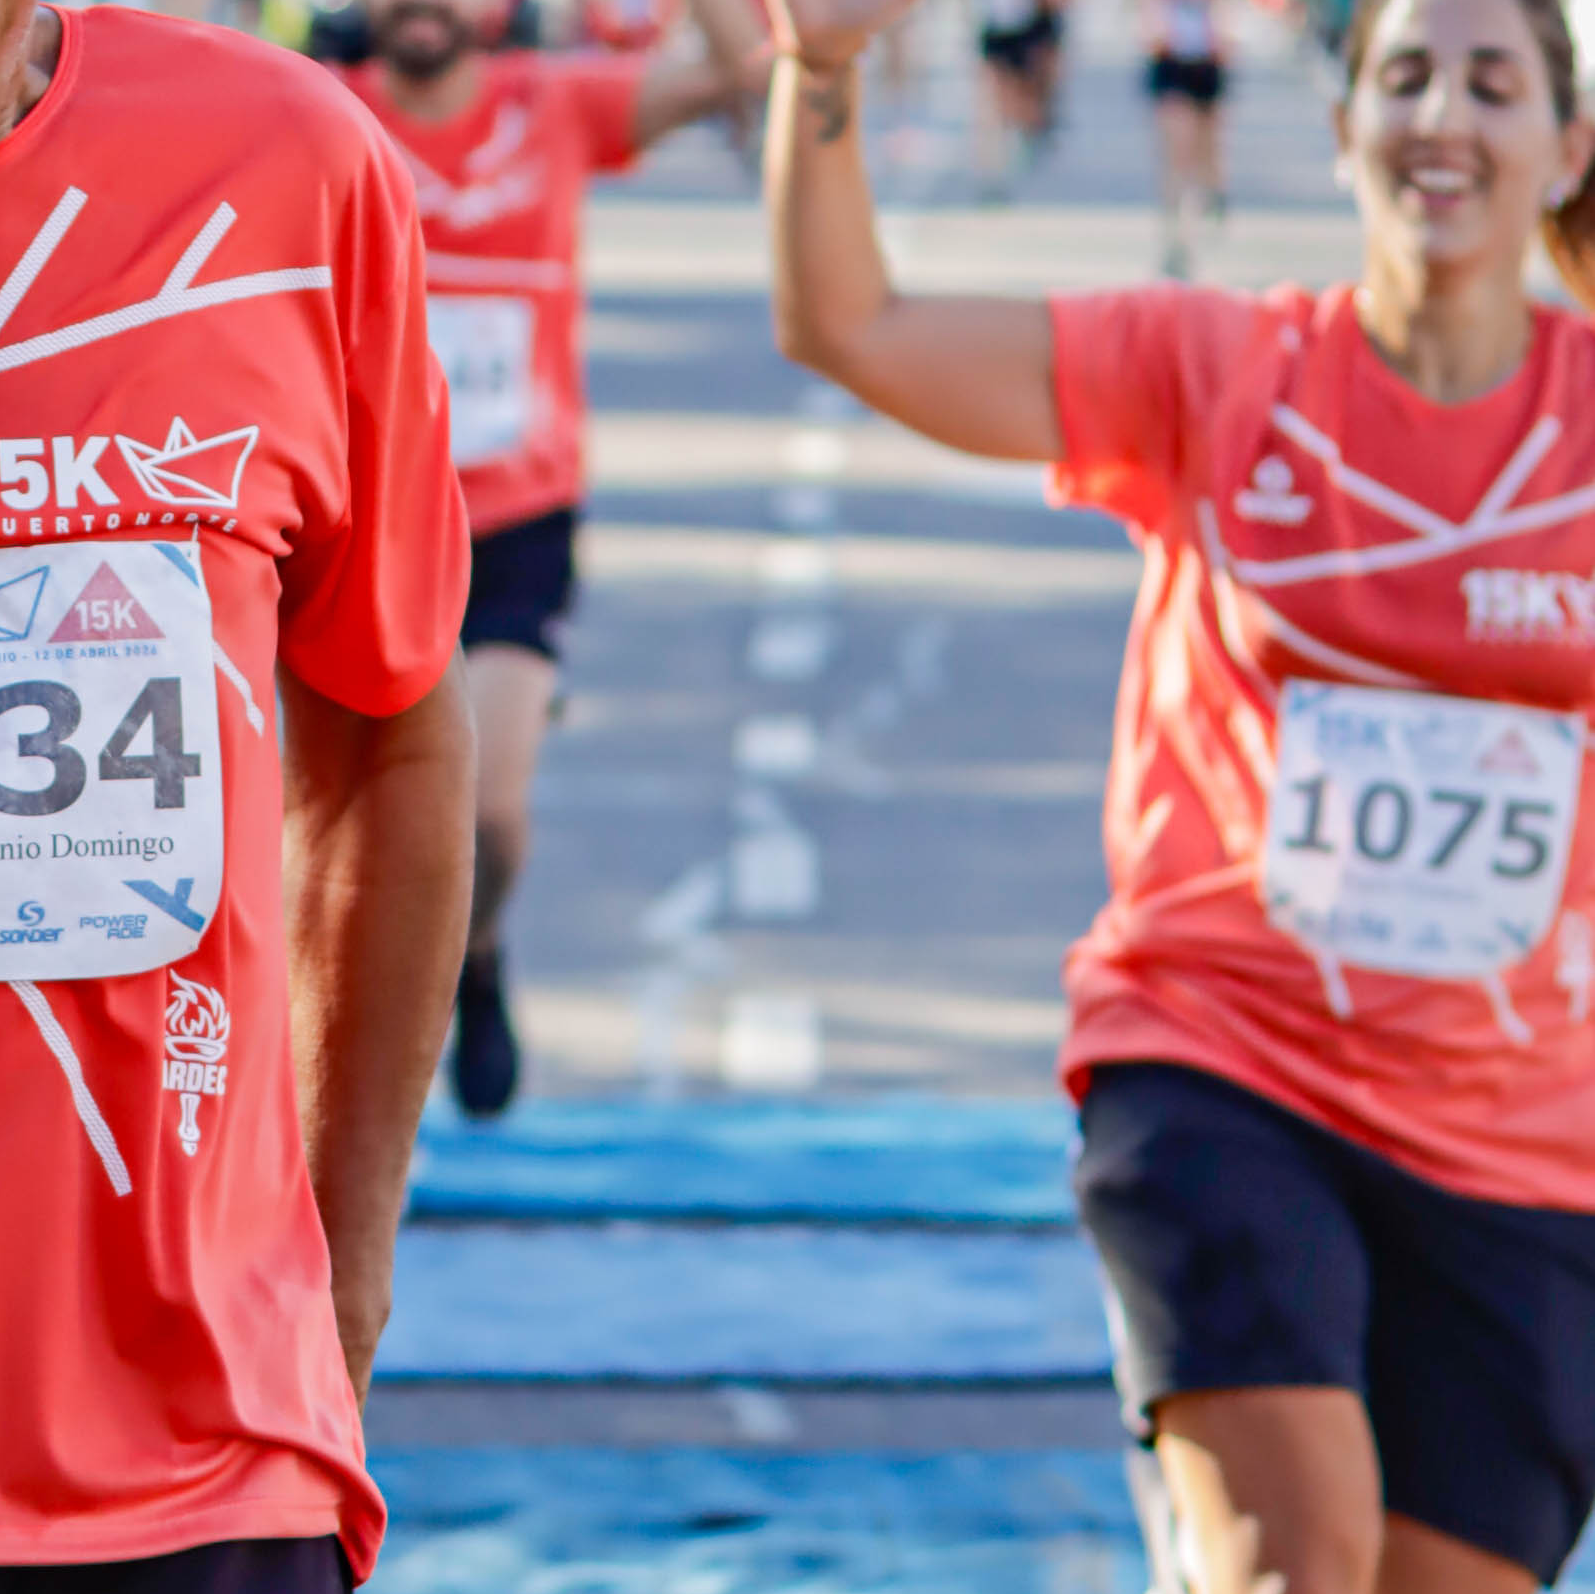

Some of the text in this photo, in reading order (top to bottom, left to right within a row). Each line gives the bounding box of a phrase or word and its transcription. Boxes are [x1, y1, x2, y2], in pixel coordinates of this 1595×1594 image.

[75, 598, 137, 631] 15K
[34, 648, 50, 661] 12
[55, 646, 75, 659] DE
[79, 644, 119, 658] ABRIL
[1283, 773, 1557, 882] 1075
[51, 831, 175, 864] Domingo
[79, 914, 148, 928] POWER
